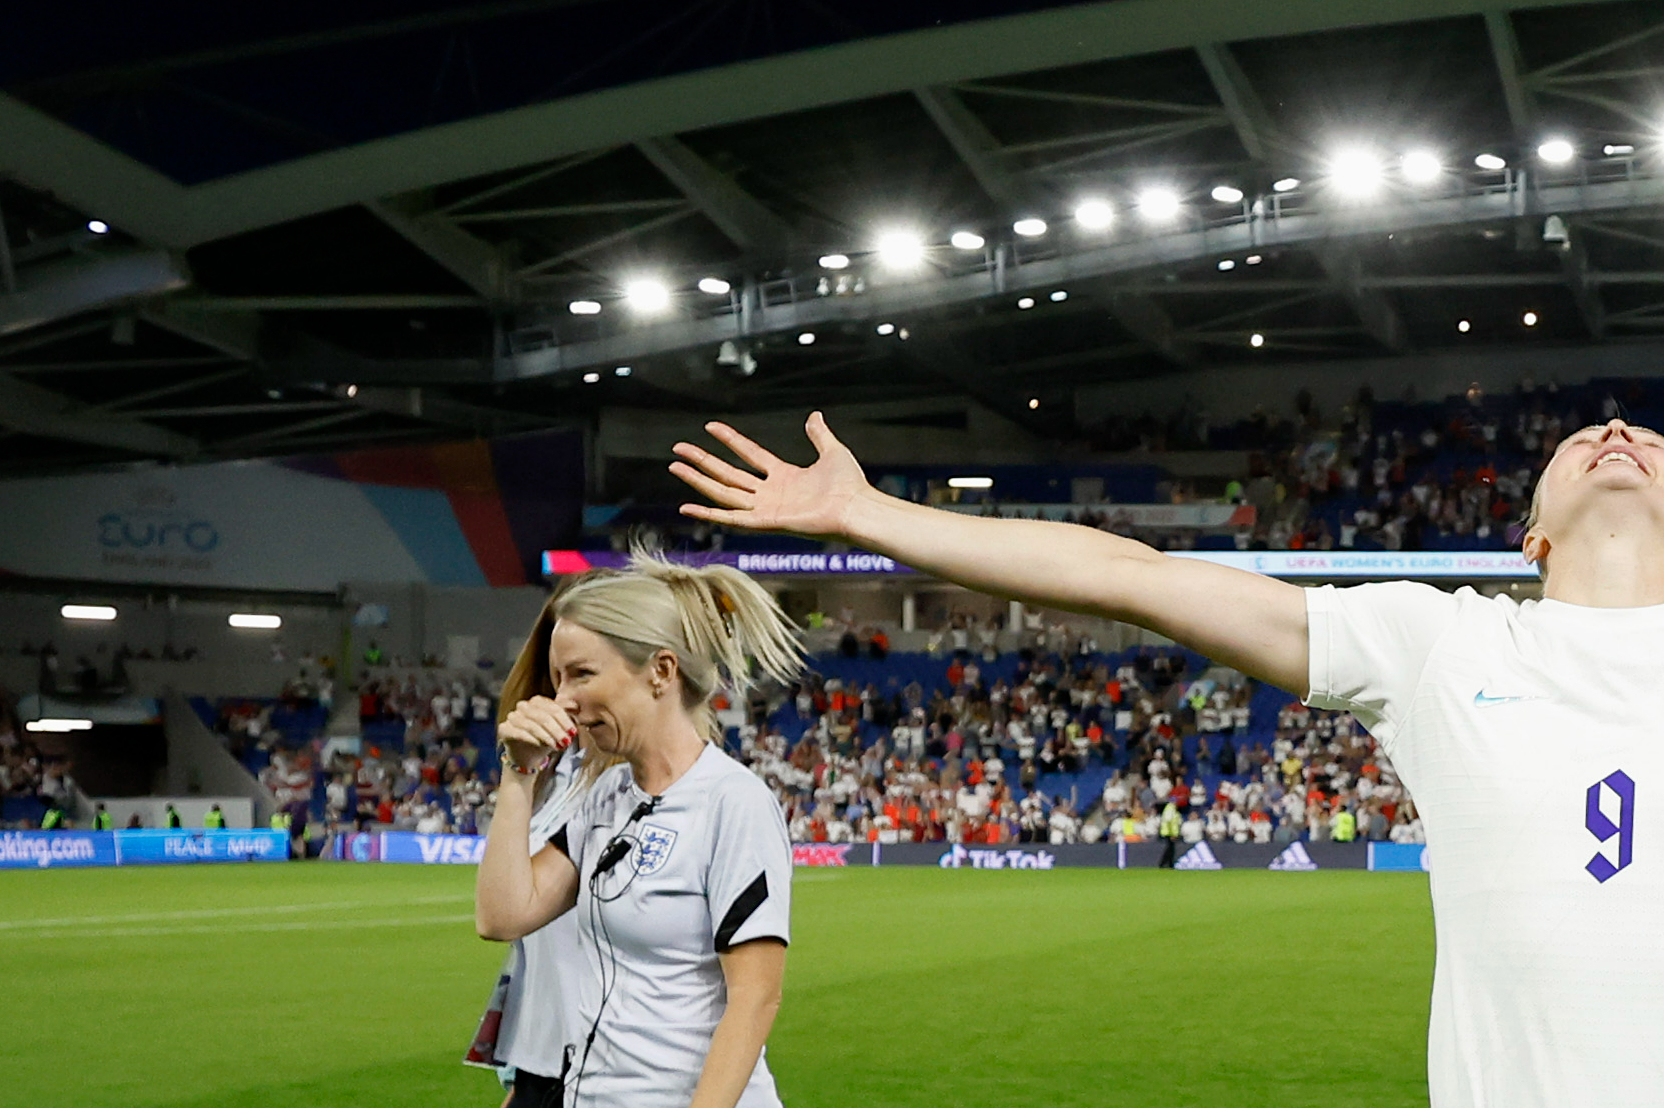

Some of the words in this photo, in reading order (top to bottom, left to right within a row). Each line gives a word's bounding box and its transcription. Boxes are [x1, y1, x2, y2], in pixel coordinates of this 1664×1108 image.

[738, 554, 826, 571] BRIGHTON
[828, 555, 843, 571] &
[846, 555, 895, 571] HOVE
[1585, 769, 1635, 884] 9
[0, 833, 94, 867] king.com
[968, 849, 1054, 870] TikTok
